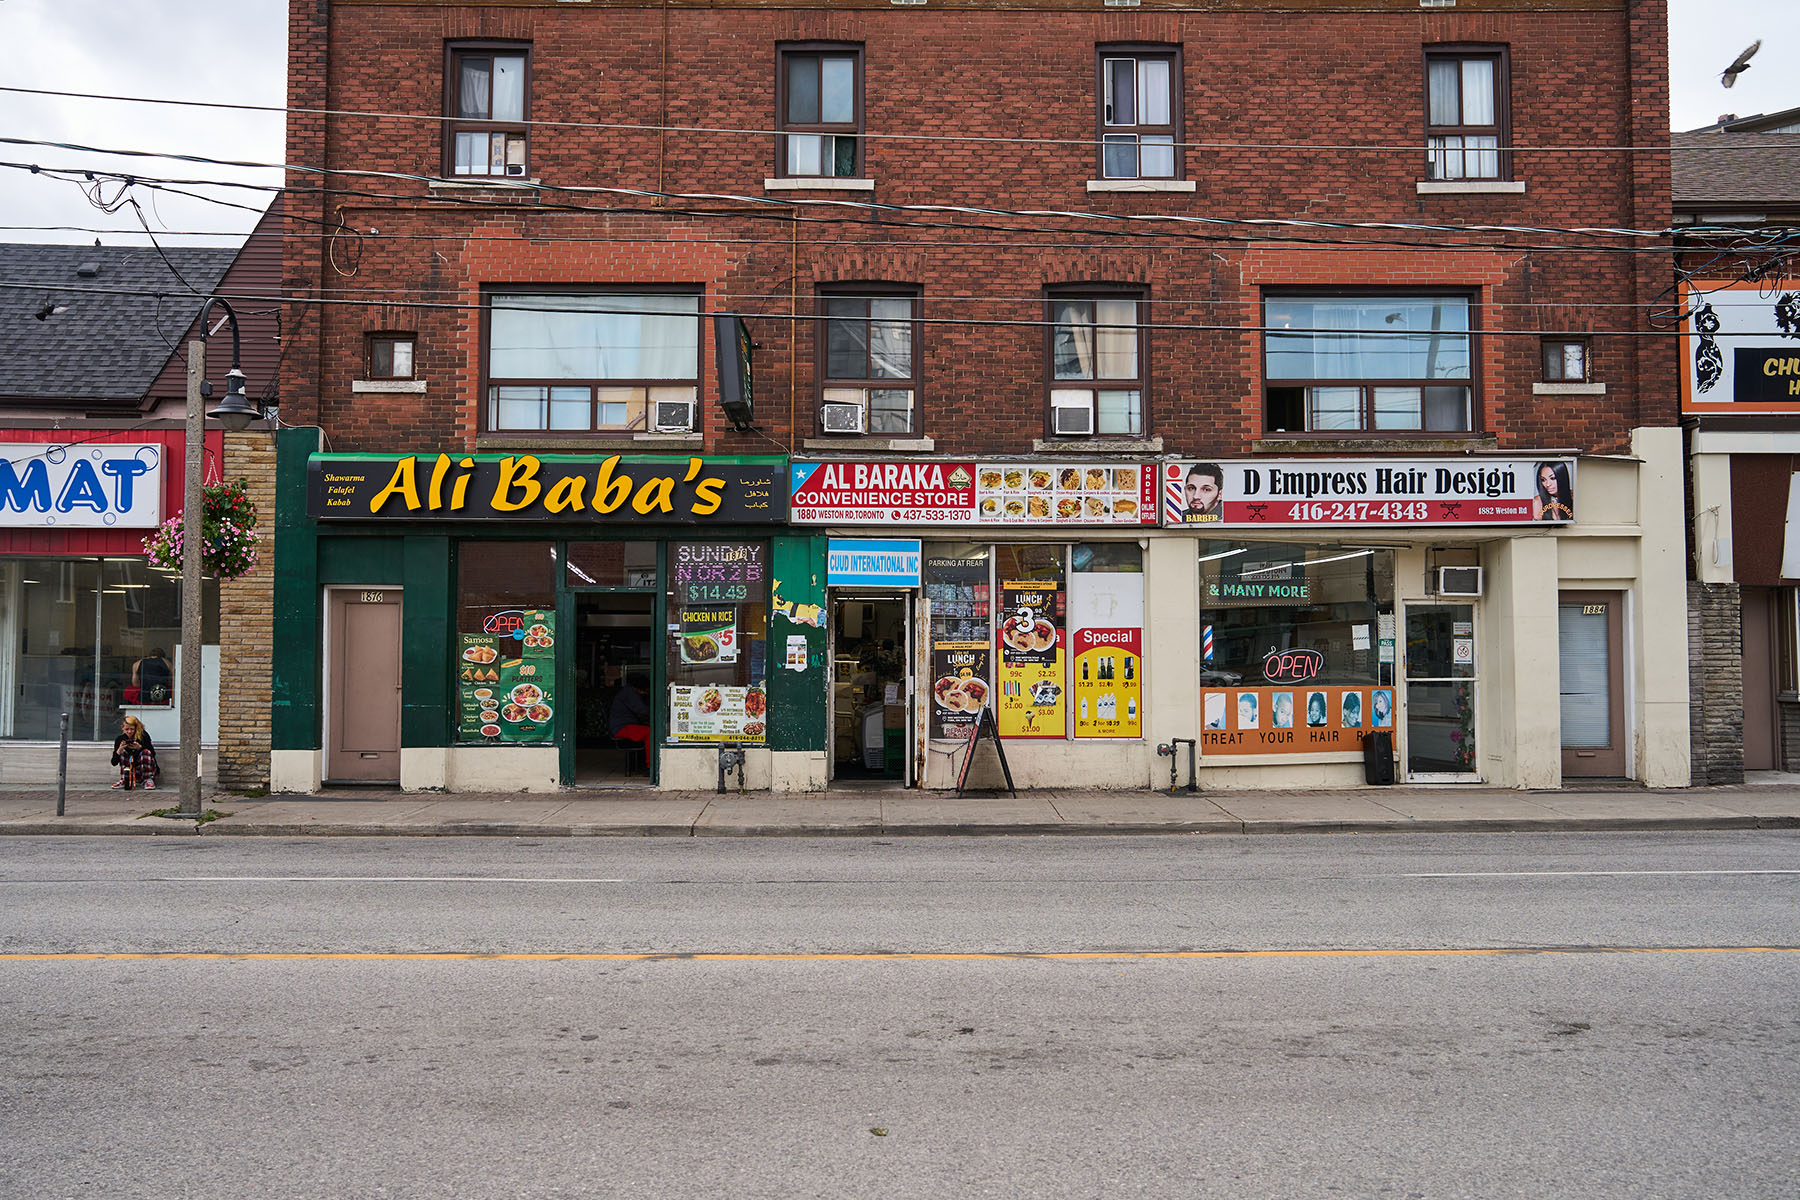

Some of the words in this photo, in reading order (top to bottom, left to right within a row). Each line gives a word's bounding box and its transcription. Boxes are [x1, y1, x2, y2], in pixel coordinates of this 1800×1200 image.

[324, 473, 365, 482] Shawarma
[822, 464, 851, 490] AL
[855, 464, 945, 490] BARAKA
[1243, 469, 1260, 495] D
[1268, 468, 1367, 498] Empress
[1375, 467, 1428, 495] Hair
[1434, 467, 1515, 498] Design
[0, 459, 147, 513] MAT
[369, 452, 475, 514] Ali
[490, 454, 727, 515] Baba's
[328, 485, 355, 495] Falafel
[327, 498, 351, 507] Kabab
[795, 491, 912, 506] CONVENIENCE
[914, 492, 969, 506] STORE
[797, 508, 816, 520] 1880
[818, 509, 844, 520] WESTON
[903, 509, 971, 521] 437-533-1370
[1288, 501, 1428, 521] 416-247-4343
[1478, 506, 1494, 515] 1882
[1495, 506, 1517, 515] Weston
[1518, 506, 1528, 515] Rd
[1186, 513, 1219, 523] BARBER
[726, 548, 748, 562] 1878
[830, 554, 849, 572] CUUD
[850, 554, 905, 573] INTERNATIONAL
[906, 555, 919, 573] INC
[928, 559, 957, 568] PARKING
[957, 559, 965, 568] AT
[966, 559, 984, 568] REAR
[361, 591, 383, 602] 1876
[689, 583, 747, 601] $14.49
[1208, 583, 1219, 596] &
[1223, 583, 1265, 597] MANY
[1268, 585, 1308, 598] MORE
[1015, 594, 1042, 605] LUNCH
[682, 611, 710, 622] CHICKEN
[711, 611, 717, 621] N
[718, 610, 733, 622] RICE
[1583, 605, 1605, 615] 1884
[463, 636, 494, 644] Samosa
[1083, 630, 1132, 646] Special
[947, 654, 975, 664] LUNCH
[519, 664, 536, 676] $10
[1265, 655, 1319, 678] OPEN
[511, 675, 543, 683] PLATTERS
[1038, 670, 1057, 678] $2.25
[1021, 725, 1041, 733] $1.00
[1203, 732, 1244, 745] TREAT
[1259, 731, 1294, 744] YOUR
[1310, 730, 1339, 743] HAIR
